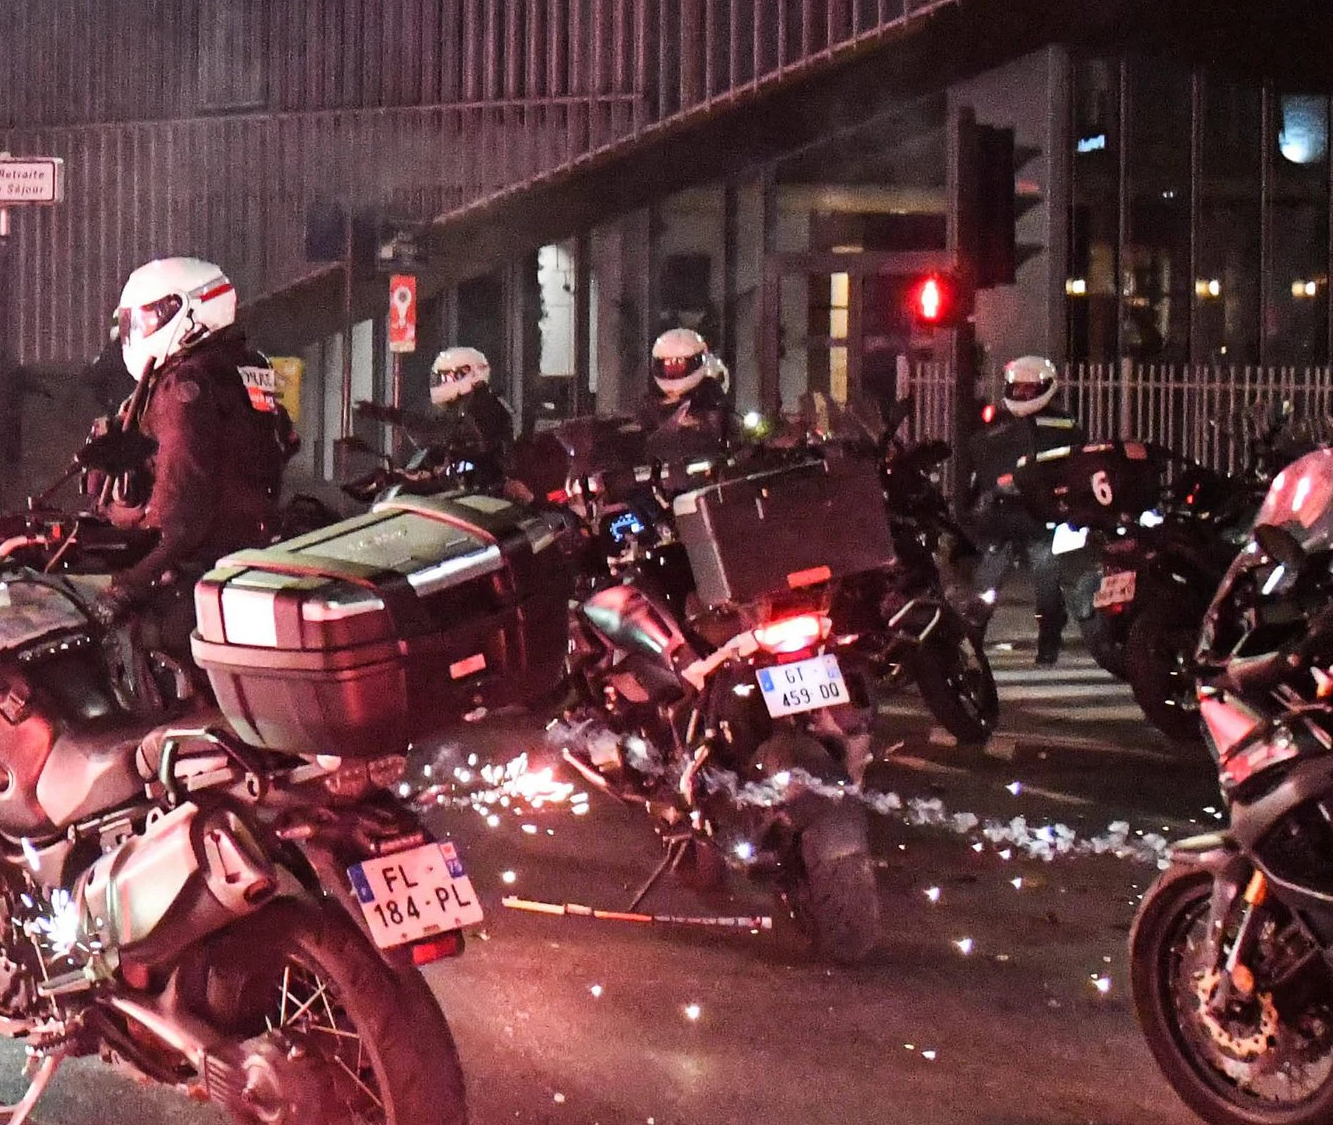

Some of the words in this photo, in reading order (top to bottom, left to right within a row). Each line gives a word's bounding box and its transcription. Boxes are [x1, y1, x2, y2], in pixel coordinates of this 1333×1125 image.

[7, 183, 44, 196] Séjour
[1092, 470, 1113, 506] 6
[382, 864, 418, 893] FL
